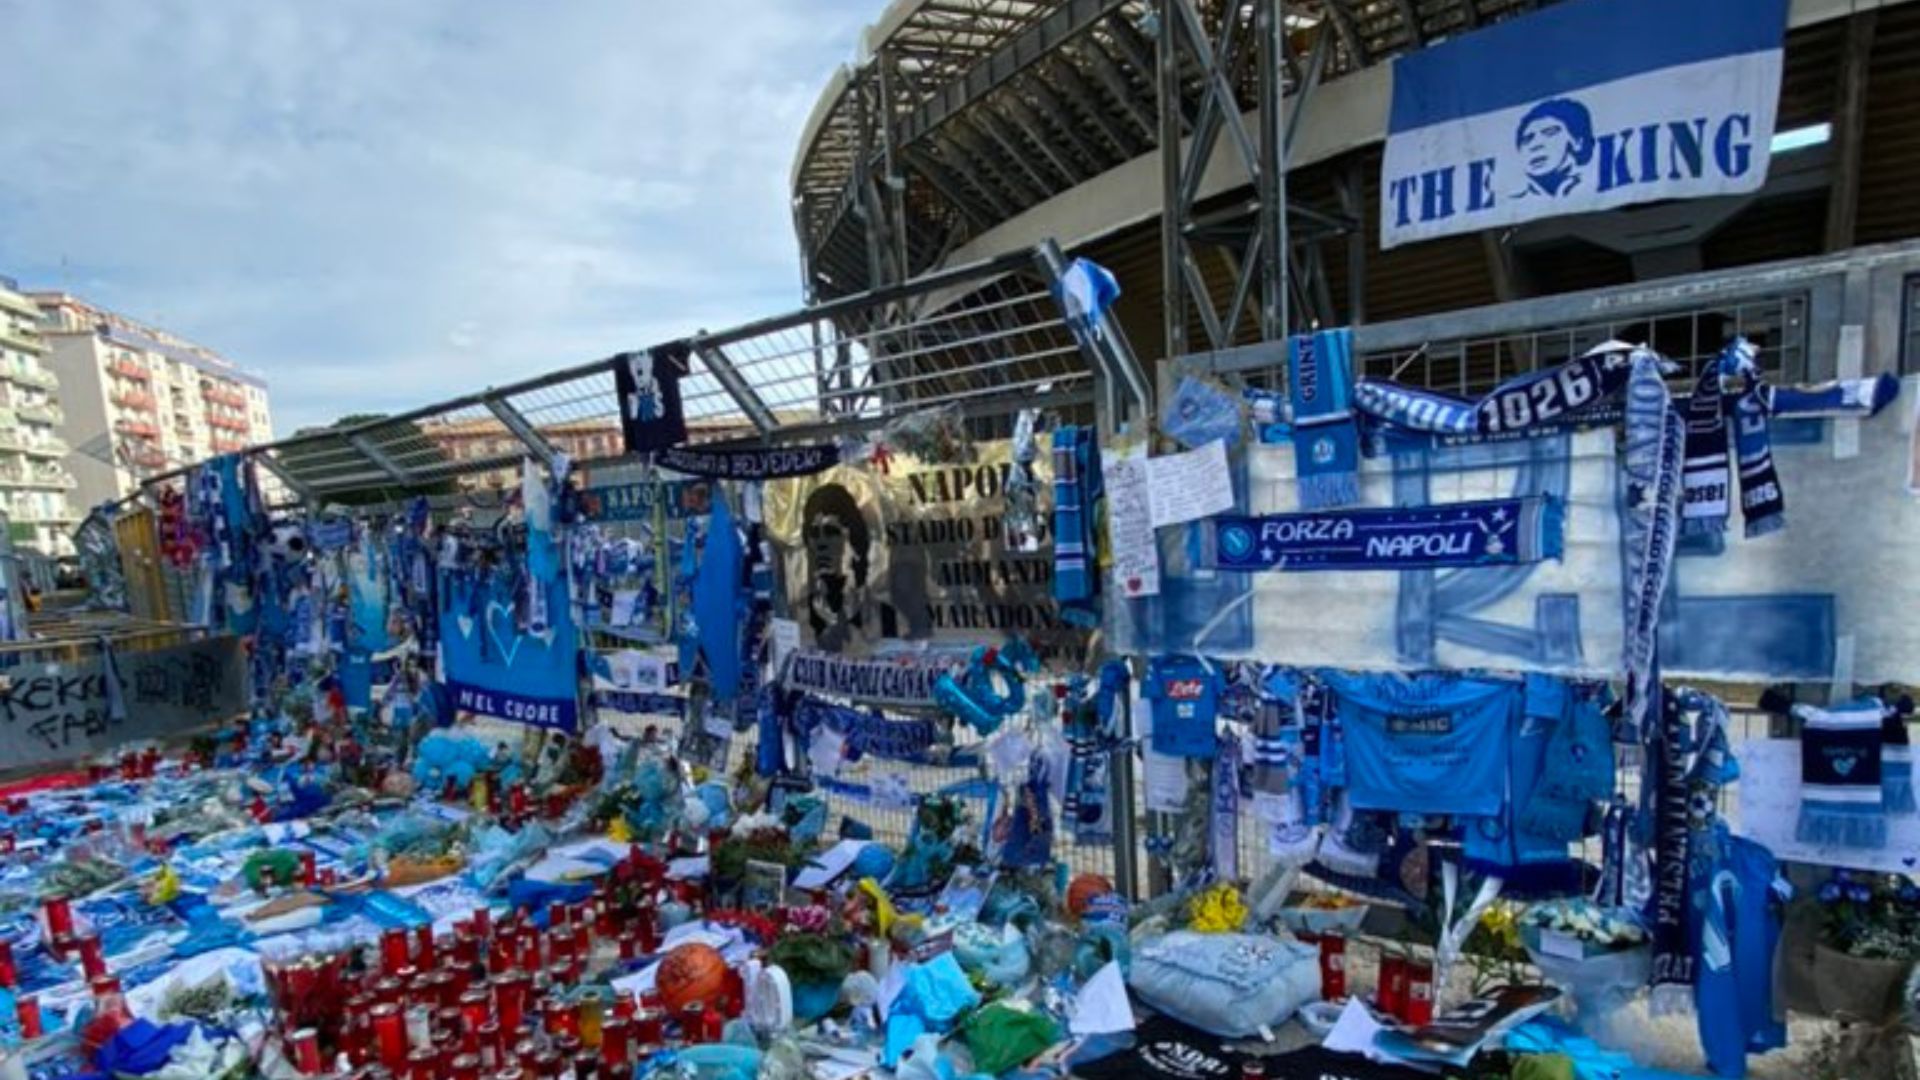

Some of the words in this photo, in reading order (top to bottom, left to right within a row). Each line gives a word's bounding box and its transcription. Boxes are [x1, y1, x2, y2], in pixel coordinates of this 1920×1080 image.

[1390, 158, 1496, 229] THE
[1596, 113, 1751, 193] KING
[1298, 335, 1318, 403] GRINT
[1482, 363, 1592, 431] 1026
[607, 483, 675, 507] NAPOI
[907, 461, 1022, 504] NAPO
[886, 516, 975, 546] STADIO
[1261, 519, 1353, 542] FORZA
[1366, 532, 1474, 557] NAPOLI
[937, 560, 1050, 586] ARMAND
[926, 602, 1056, 630] MARADON
[829, 661, 881, 696] NAPOLI
[459, 689, 495, 713] NEL
[504, 699, 560, 723] CUORE
